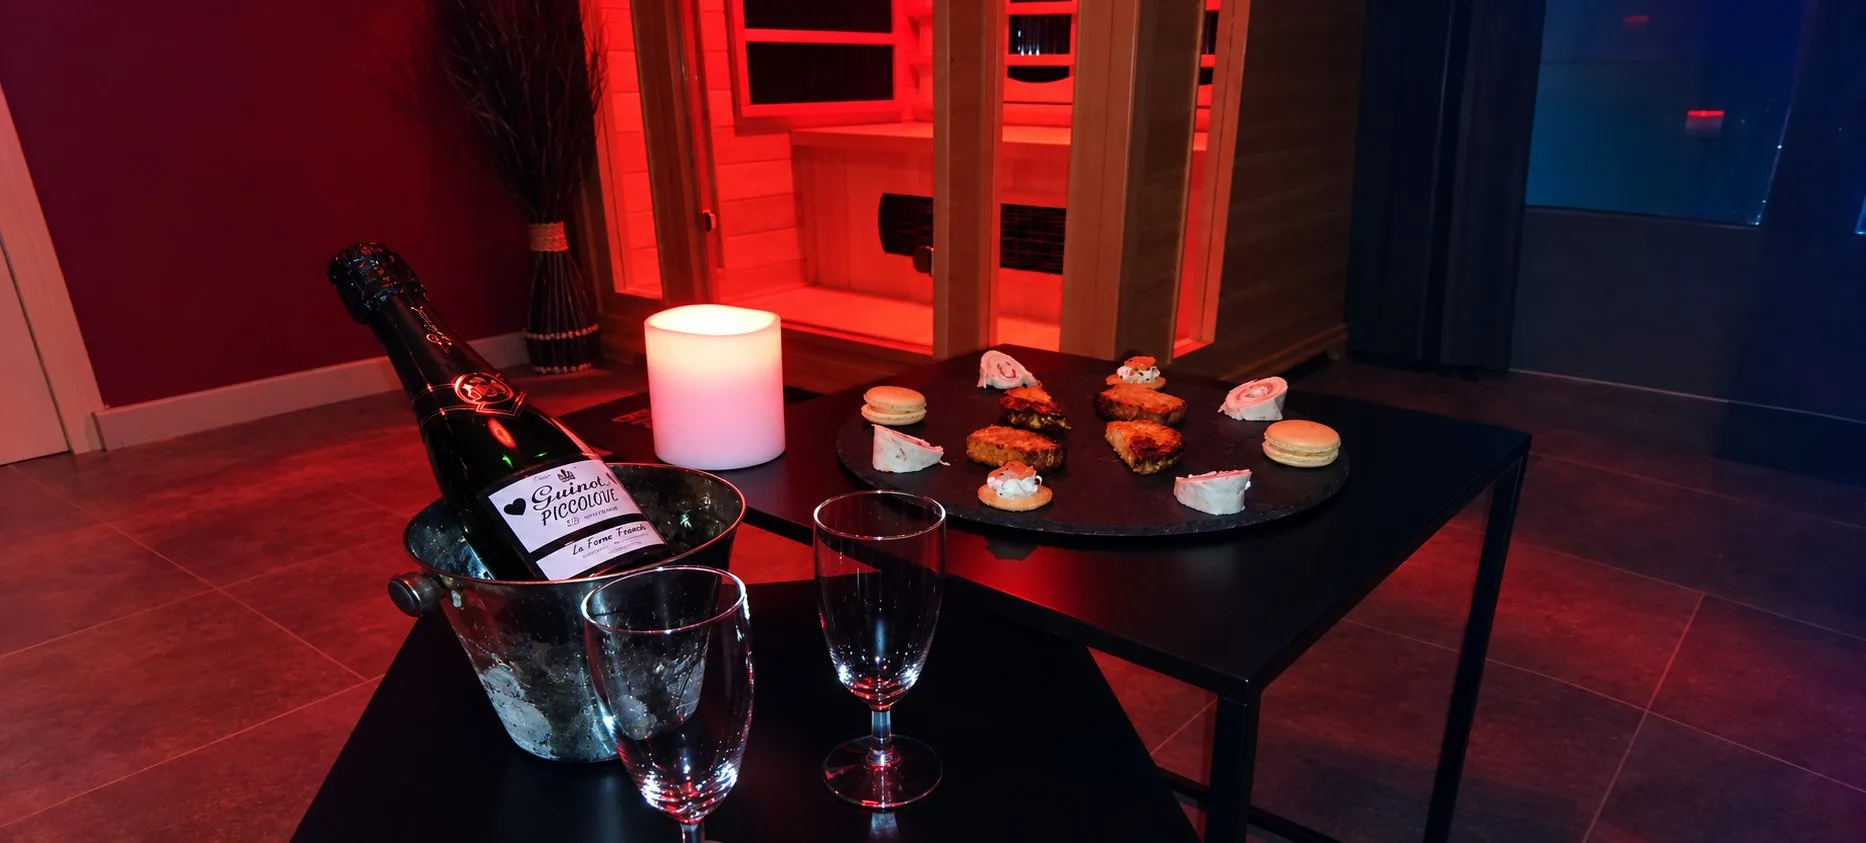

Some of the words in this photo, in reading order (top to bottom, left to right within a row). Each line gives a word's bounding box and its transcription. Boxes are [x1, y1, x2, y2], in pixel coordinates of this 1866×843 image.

[531, 476, 607, 511] Guinot
[541, 489, 619, 526] PICCOLOVE
[572, 539, 584, 556] La
